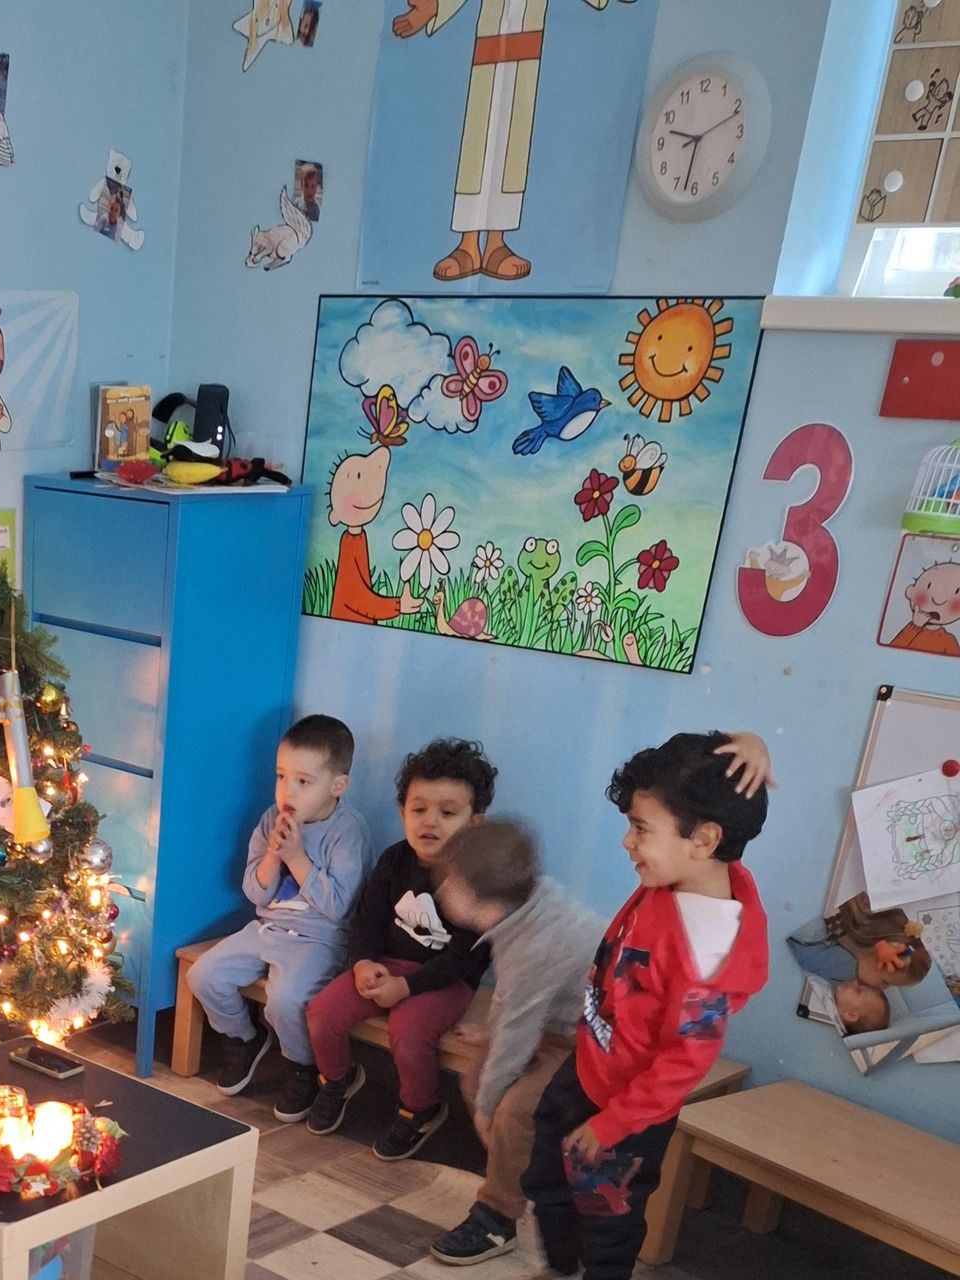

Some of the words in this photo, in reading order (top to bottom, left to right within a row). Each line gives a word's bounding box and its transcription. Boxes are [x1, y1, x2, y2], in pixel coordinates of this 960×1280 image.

[700, 78, 711, 93] 12
[722, 83, 727, 97] 1
[680, 88, 690, 105] 11
[734, 98, 742, 115] 2
[664, 110, 676, 125] 10
[736, 124, 744, 139] 3
[657, 136, 665, 151] 9
[727, 151, 736, 165] 4
[660, 161, 668, 176] 8
[673, 176, 681, 191] 7
[712, 172, 720, 186] 5
[690, 182, 699, 197] 6
[737, 422, 854, 638] 3
